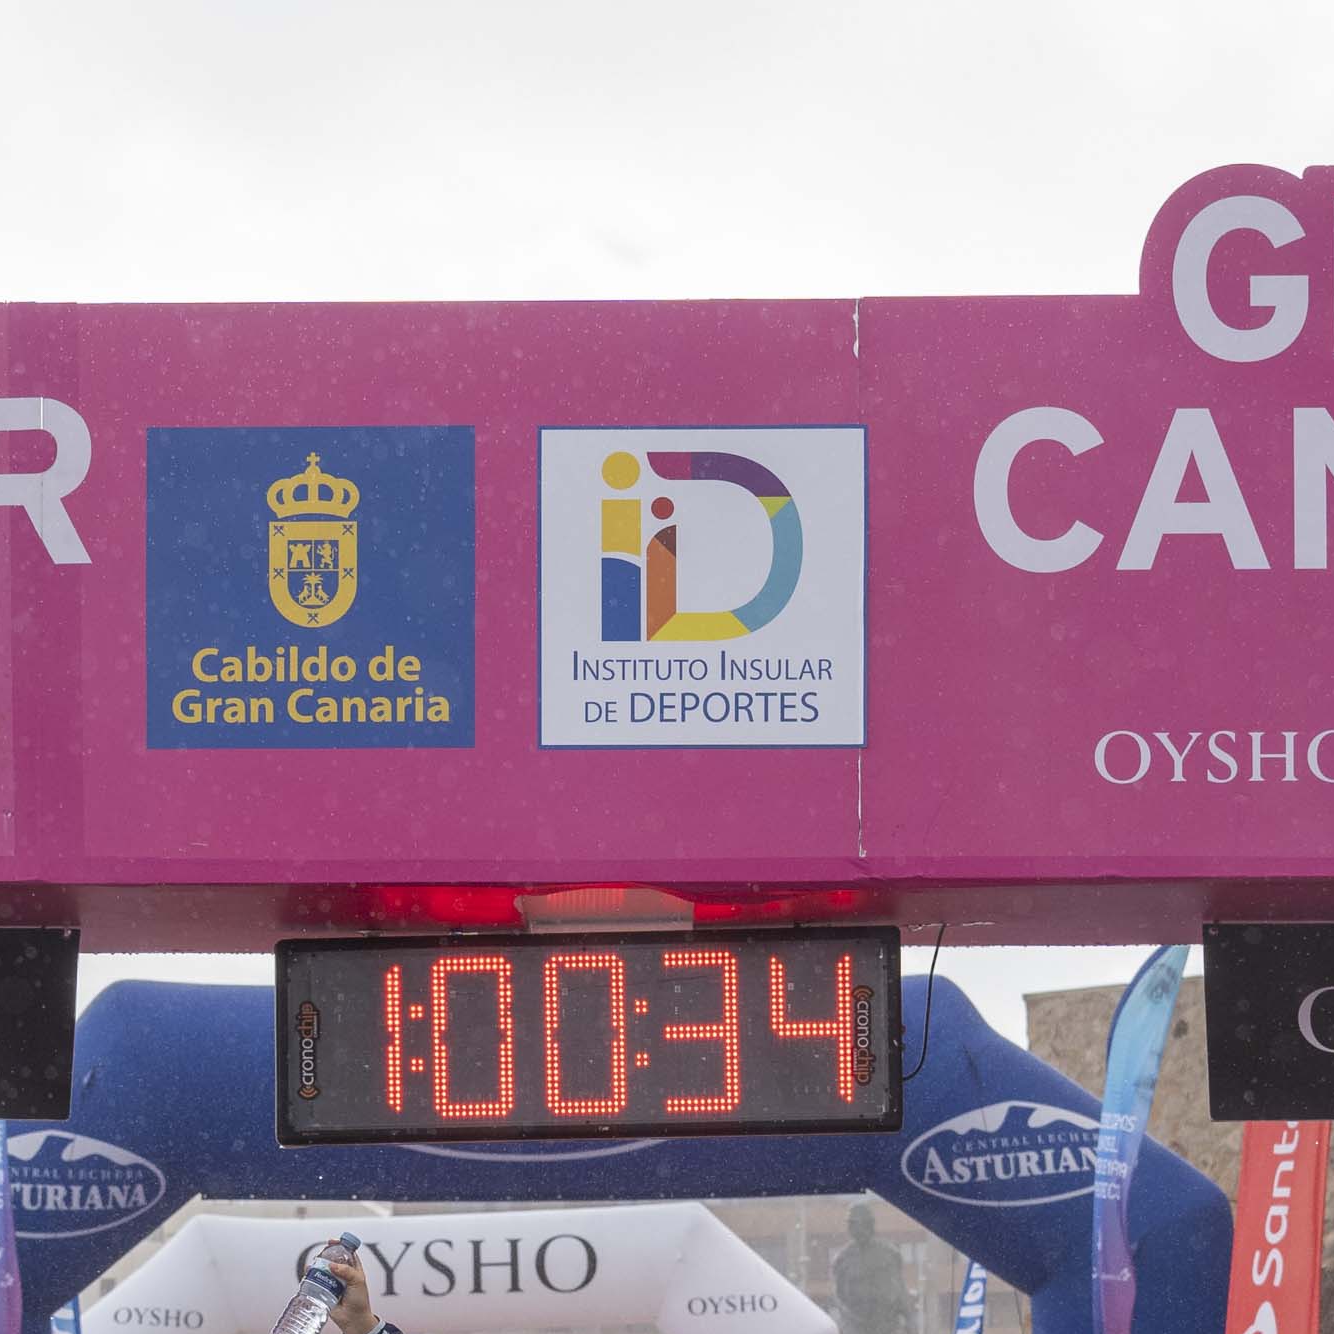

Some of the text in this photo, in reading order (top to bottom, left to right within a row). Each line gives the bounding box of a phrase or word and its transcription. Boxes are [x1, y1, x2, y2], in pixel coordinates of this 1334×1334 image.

[192, 646, 421, 682] Cabildo de
[574, 651, 832, 680] INSTITUTO INSULAR
[172, 687, 449, 723] Gran Canaria
[585, 692, 818, 722] DE DEPORTES
[299, 1003, 318, 1086] cronochip
[385, 950, 852, 1119] 1:00:34
[857, 1000, 876, 1083] cronochip
[10, 1166, 58, 1178] NTRAL
[922, 1146, 1098, 1186] ASTURIAN
[11, 1183, 147, 1211] TURIANA
[114, 1307, 204, 1329] OYSHO
[687, 1294, 778, 1316] OYSHO
